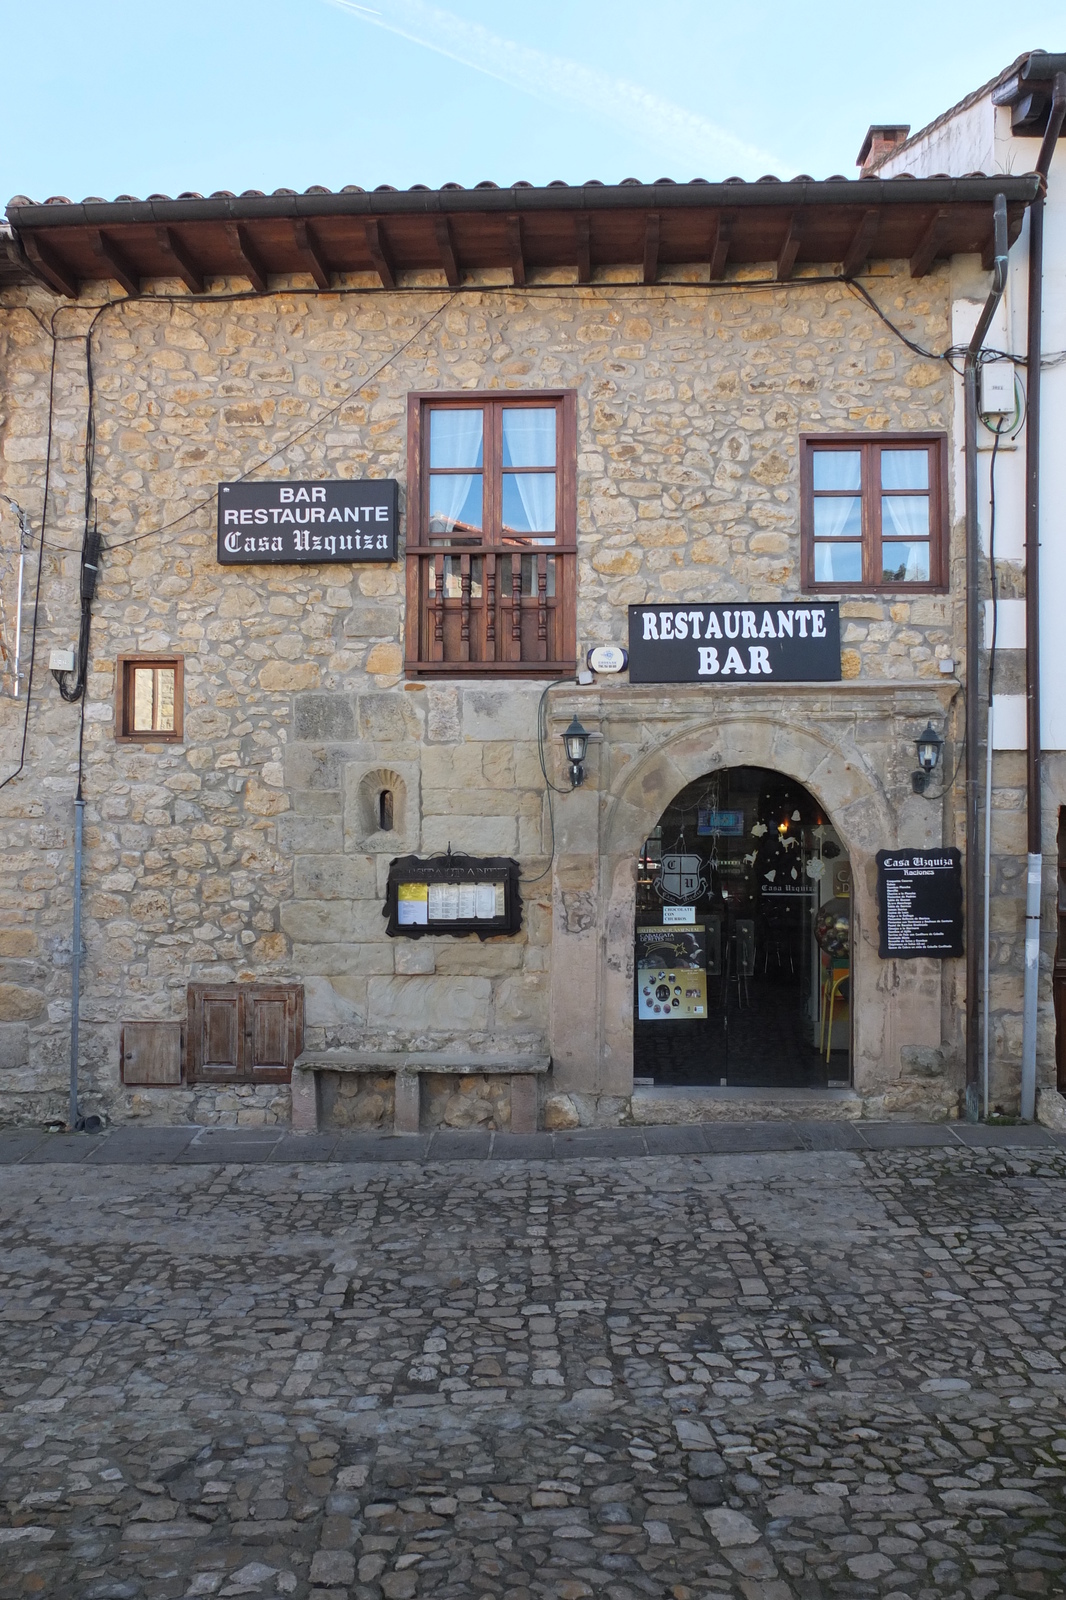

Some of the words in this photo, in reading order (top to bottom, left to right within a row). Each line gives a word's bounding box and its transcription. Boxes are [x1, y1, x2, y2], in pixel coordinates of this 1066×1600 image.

[279, 487, 327, 503] BAR
[224, 506, 389, 525] RESTAURANTE
[224, 531, 283, 553] Casa
[292, 529, 388, 555] Uzquiza
[643, 610, 826, 640] RESTAURANTE
[698, 646, 773, 675] BAR
[667, 860, 676, 870] C
[884, 858, 910, 867] Casa
[913, 857, 953, 867] Uzquiza
[685, 879, 693, 888] U
[761, 884, 782, 892] Casa
[785, 884, 817, 892] Uzquiza
